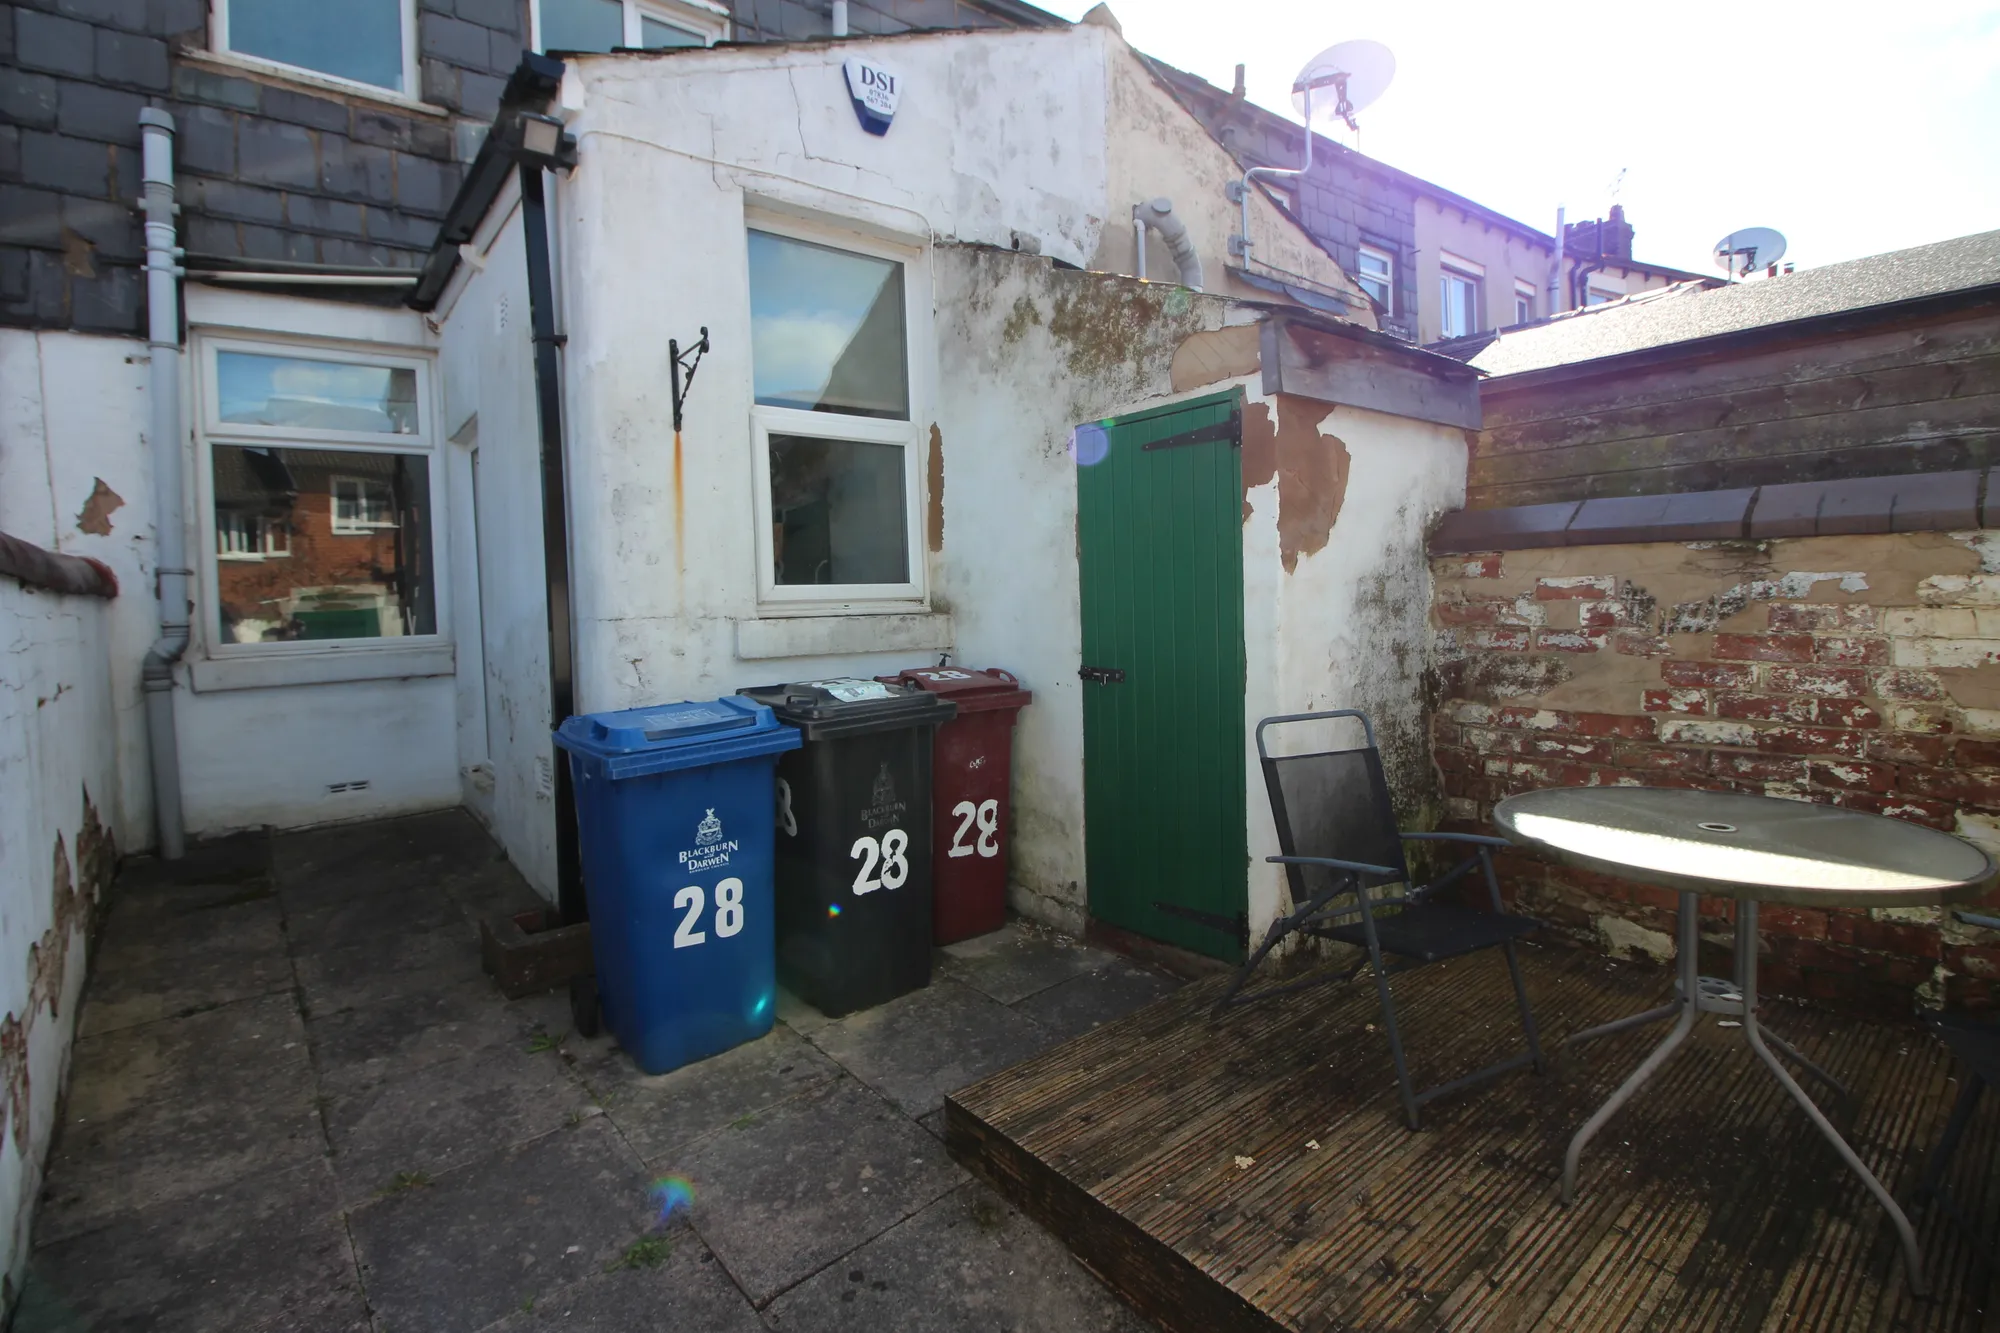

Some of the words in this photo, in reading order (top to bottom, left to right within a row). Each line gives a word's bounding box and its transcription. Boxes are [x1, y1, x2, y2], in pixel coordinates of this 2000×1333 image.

[861, 65, 895, 95] DSI
[917, 670, 972, 681] 28
[777, 777, 797, 837] 8
[948, 799, 999, 858] 28
[679, 840, 738, 863] BLACKBURN
[688, 852, 729, 871] DARWEN
[850, 829, 908, 896] 28
[674, 877, 744, 949] 28
